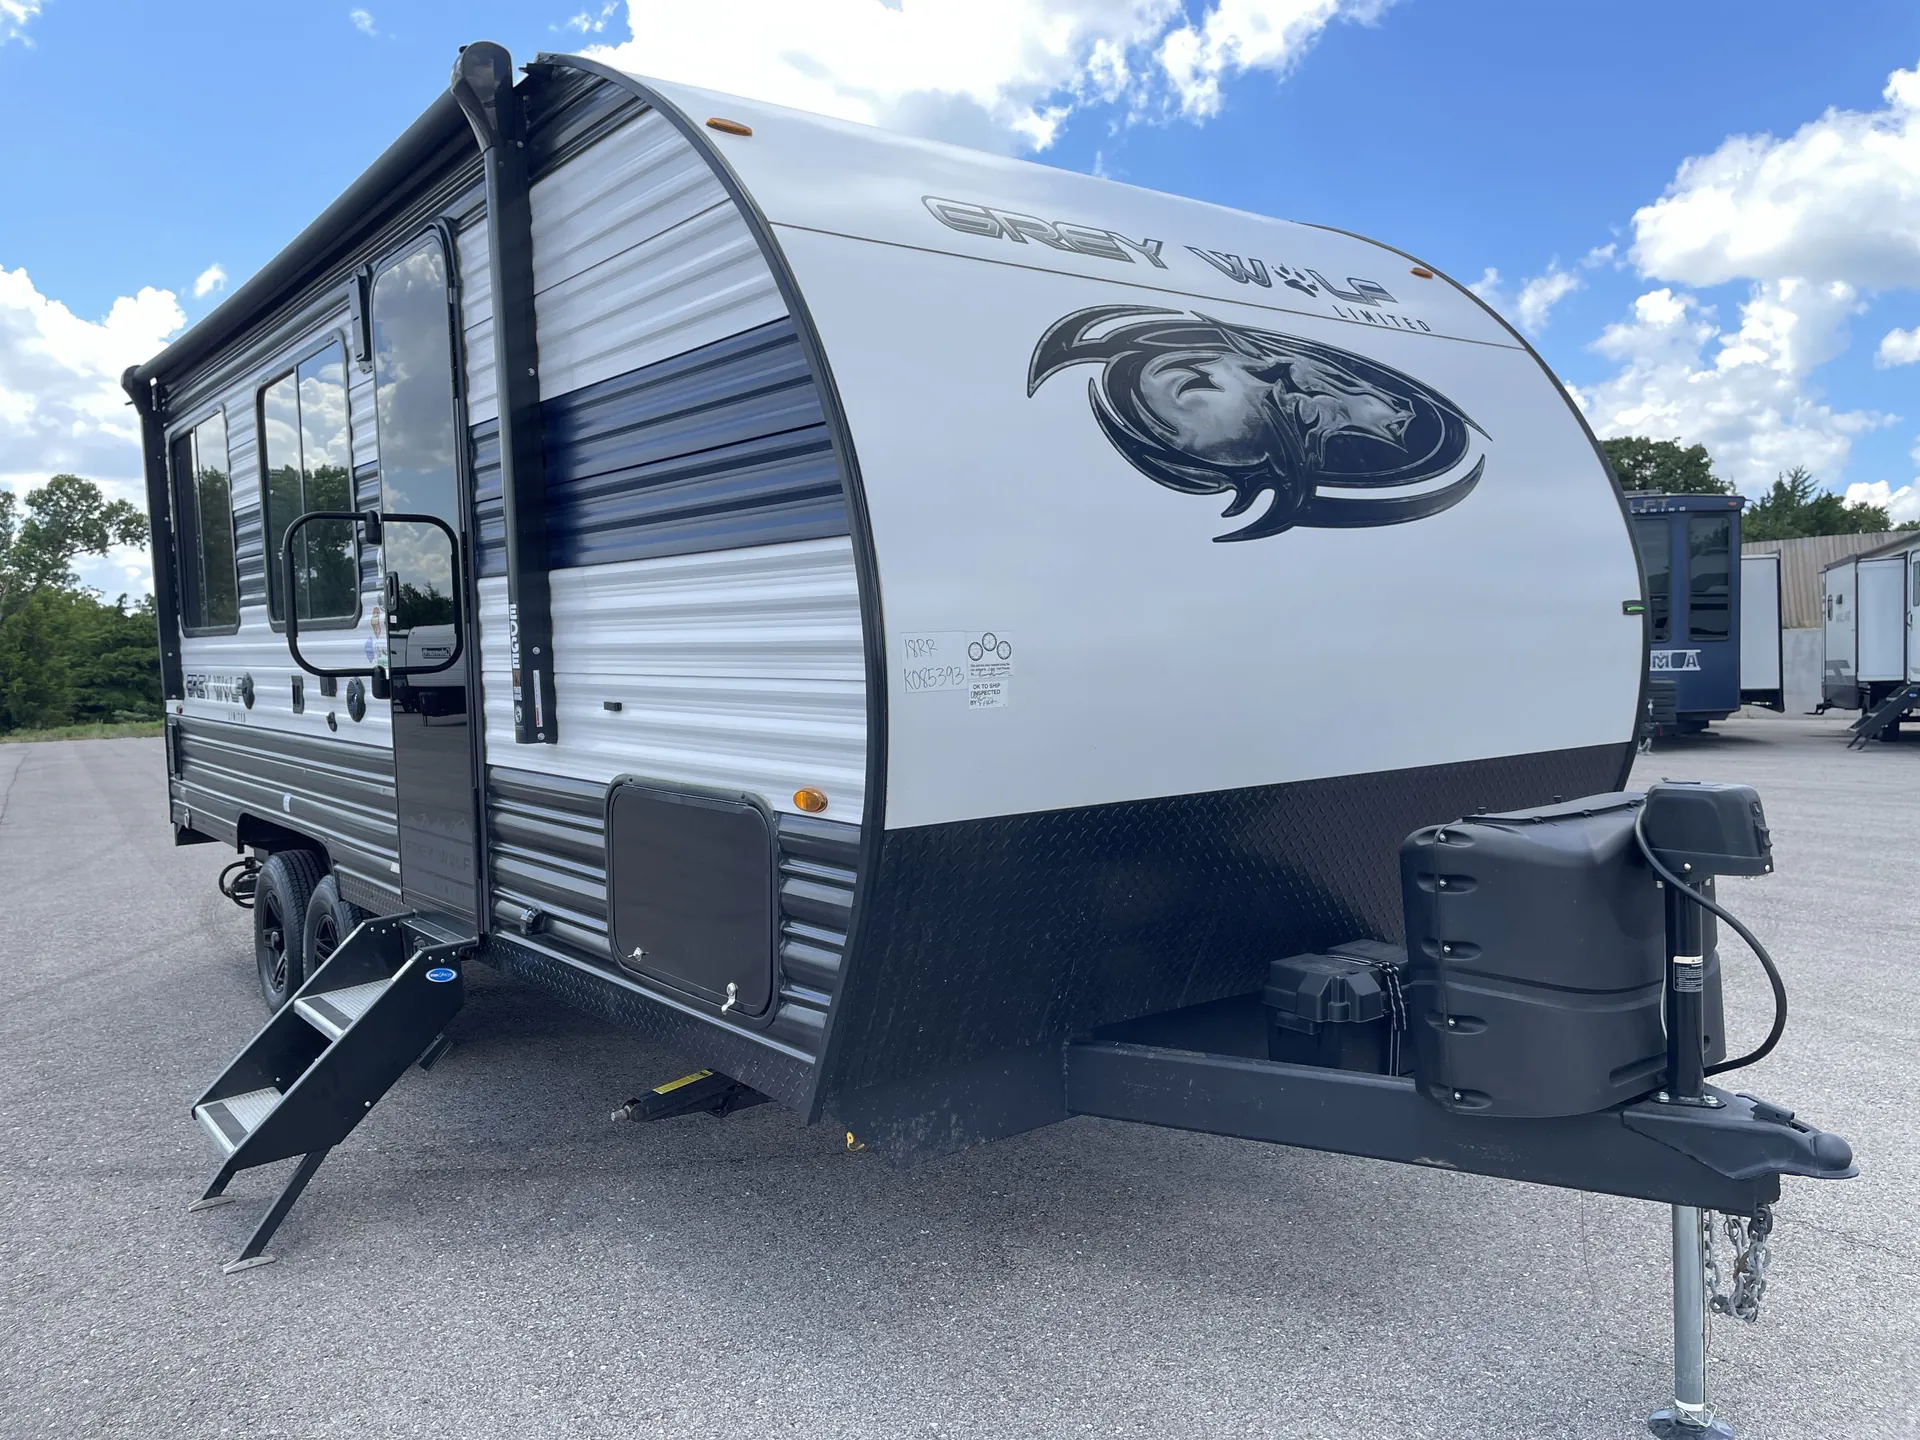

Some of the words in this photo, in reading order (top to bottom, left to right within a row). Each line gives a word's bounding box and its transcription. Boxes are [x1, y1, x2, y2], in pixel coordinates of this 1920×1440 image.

[922, 195, 1169, 269] GREY
[1332, 304, 1432, 333] LIMITED
[509, 603, 521, 669] EDGE
[904, 638, 939, 660] 18RR
